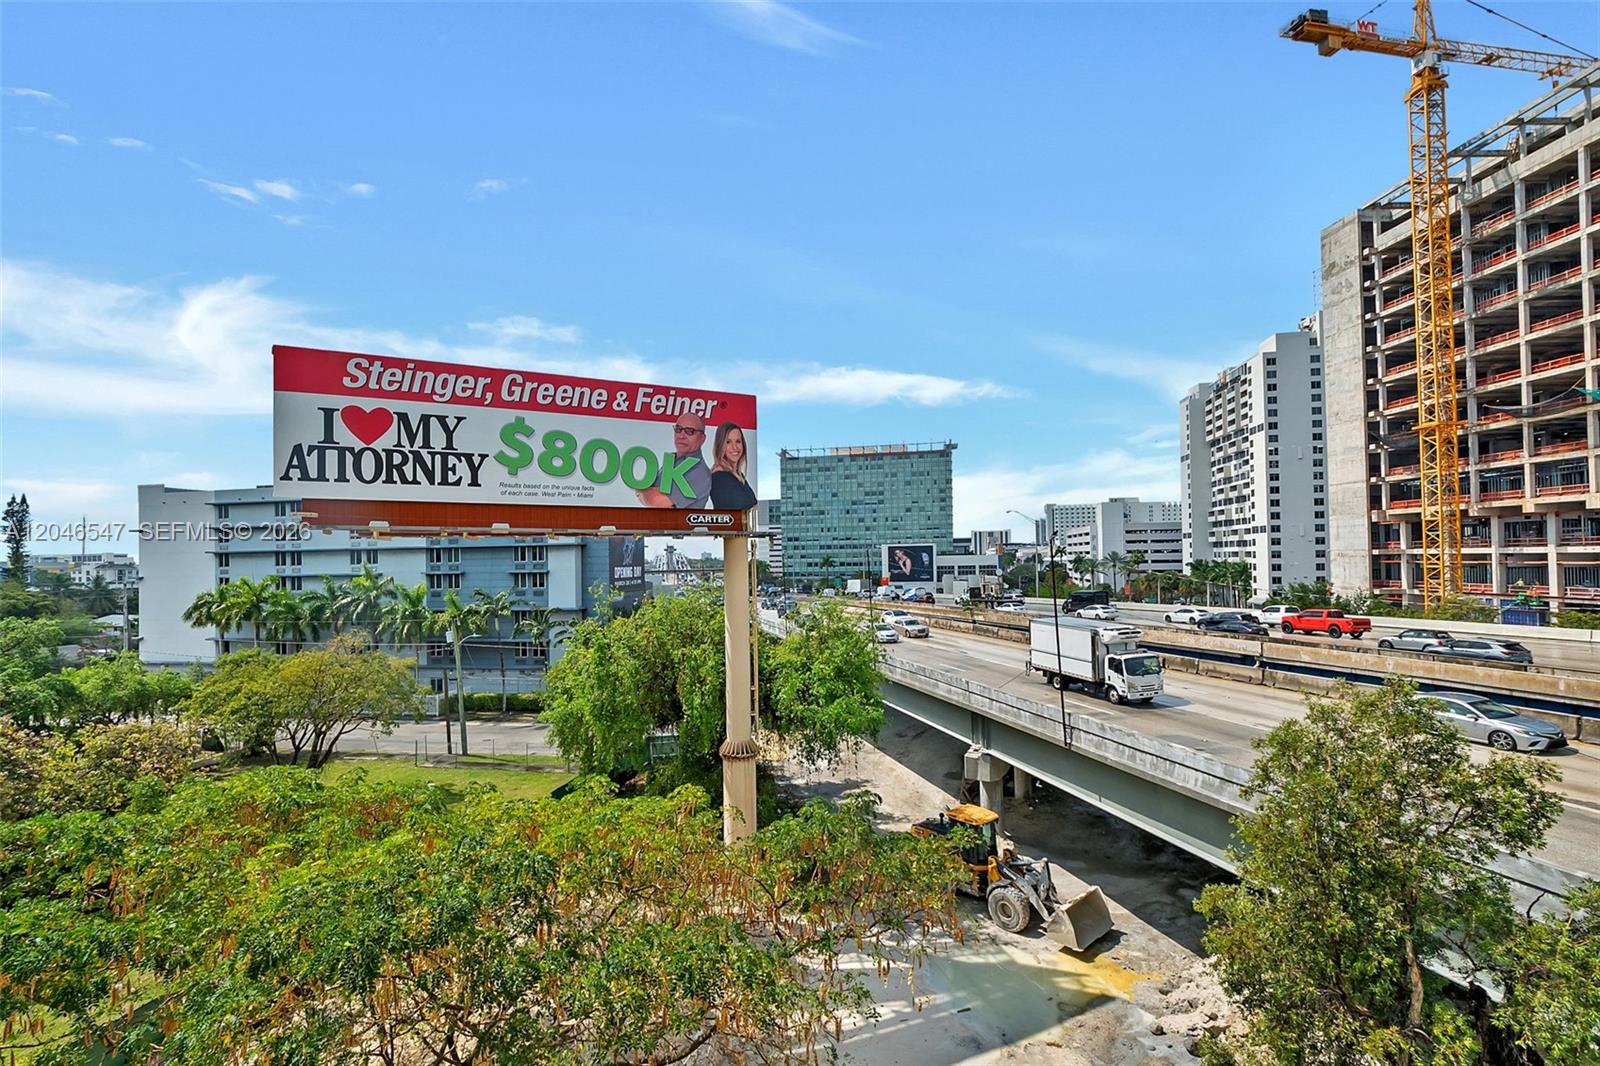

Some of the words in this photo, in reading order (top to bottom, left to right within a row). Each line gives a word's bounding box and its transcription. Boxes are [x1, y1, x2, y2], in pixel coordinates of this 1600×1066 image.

[342, 357, 494, 405] Steinger,
[501, 373, 609, 409] Greene
[612, 390, 629, 412] &
[634, 387, 718, 418] Feiner
[317, 407, 340, 445] I
[392, 411, 467, 450] MY
[279, 442, 489, 487] ATTORNEY
[493, 416, 700, 499] $800K
[690, 515, 730, 523] CARTER
